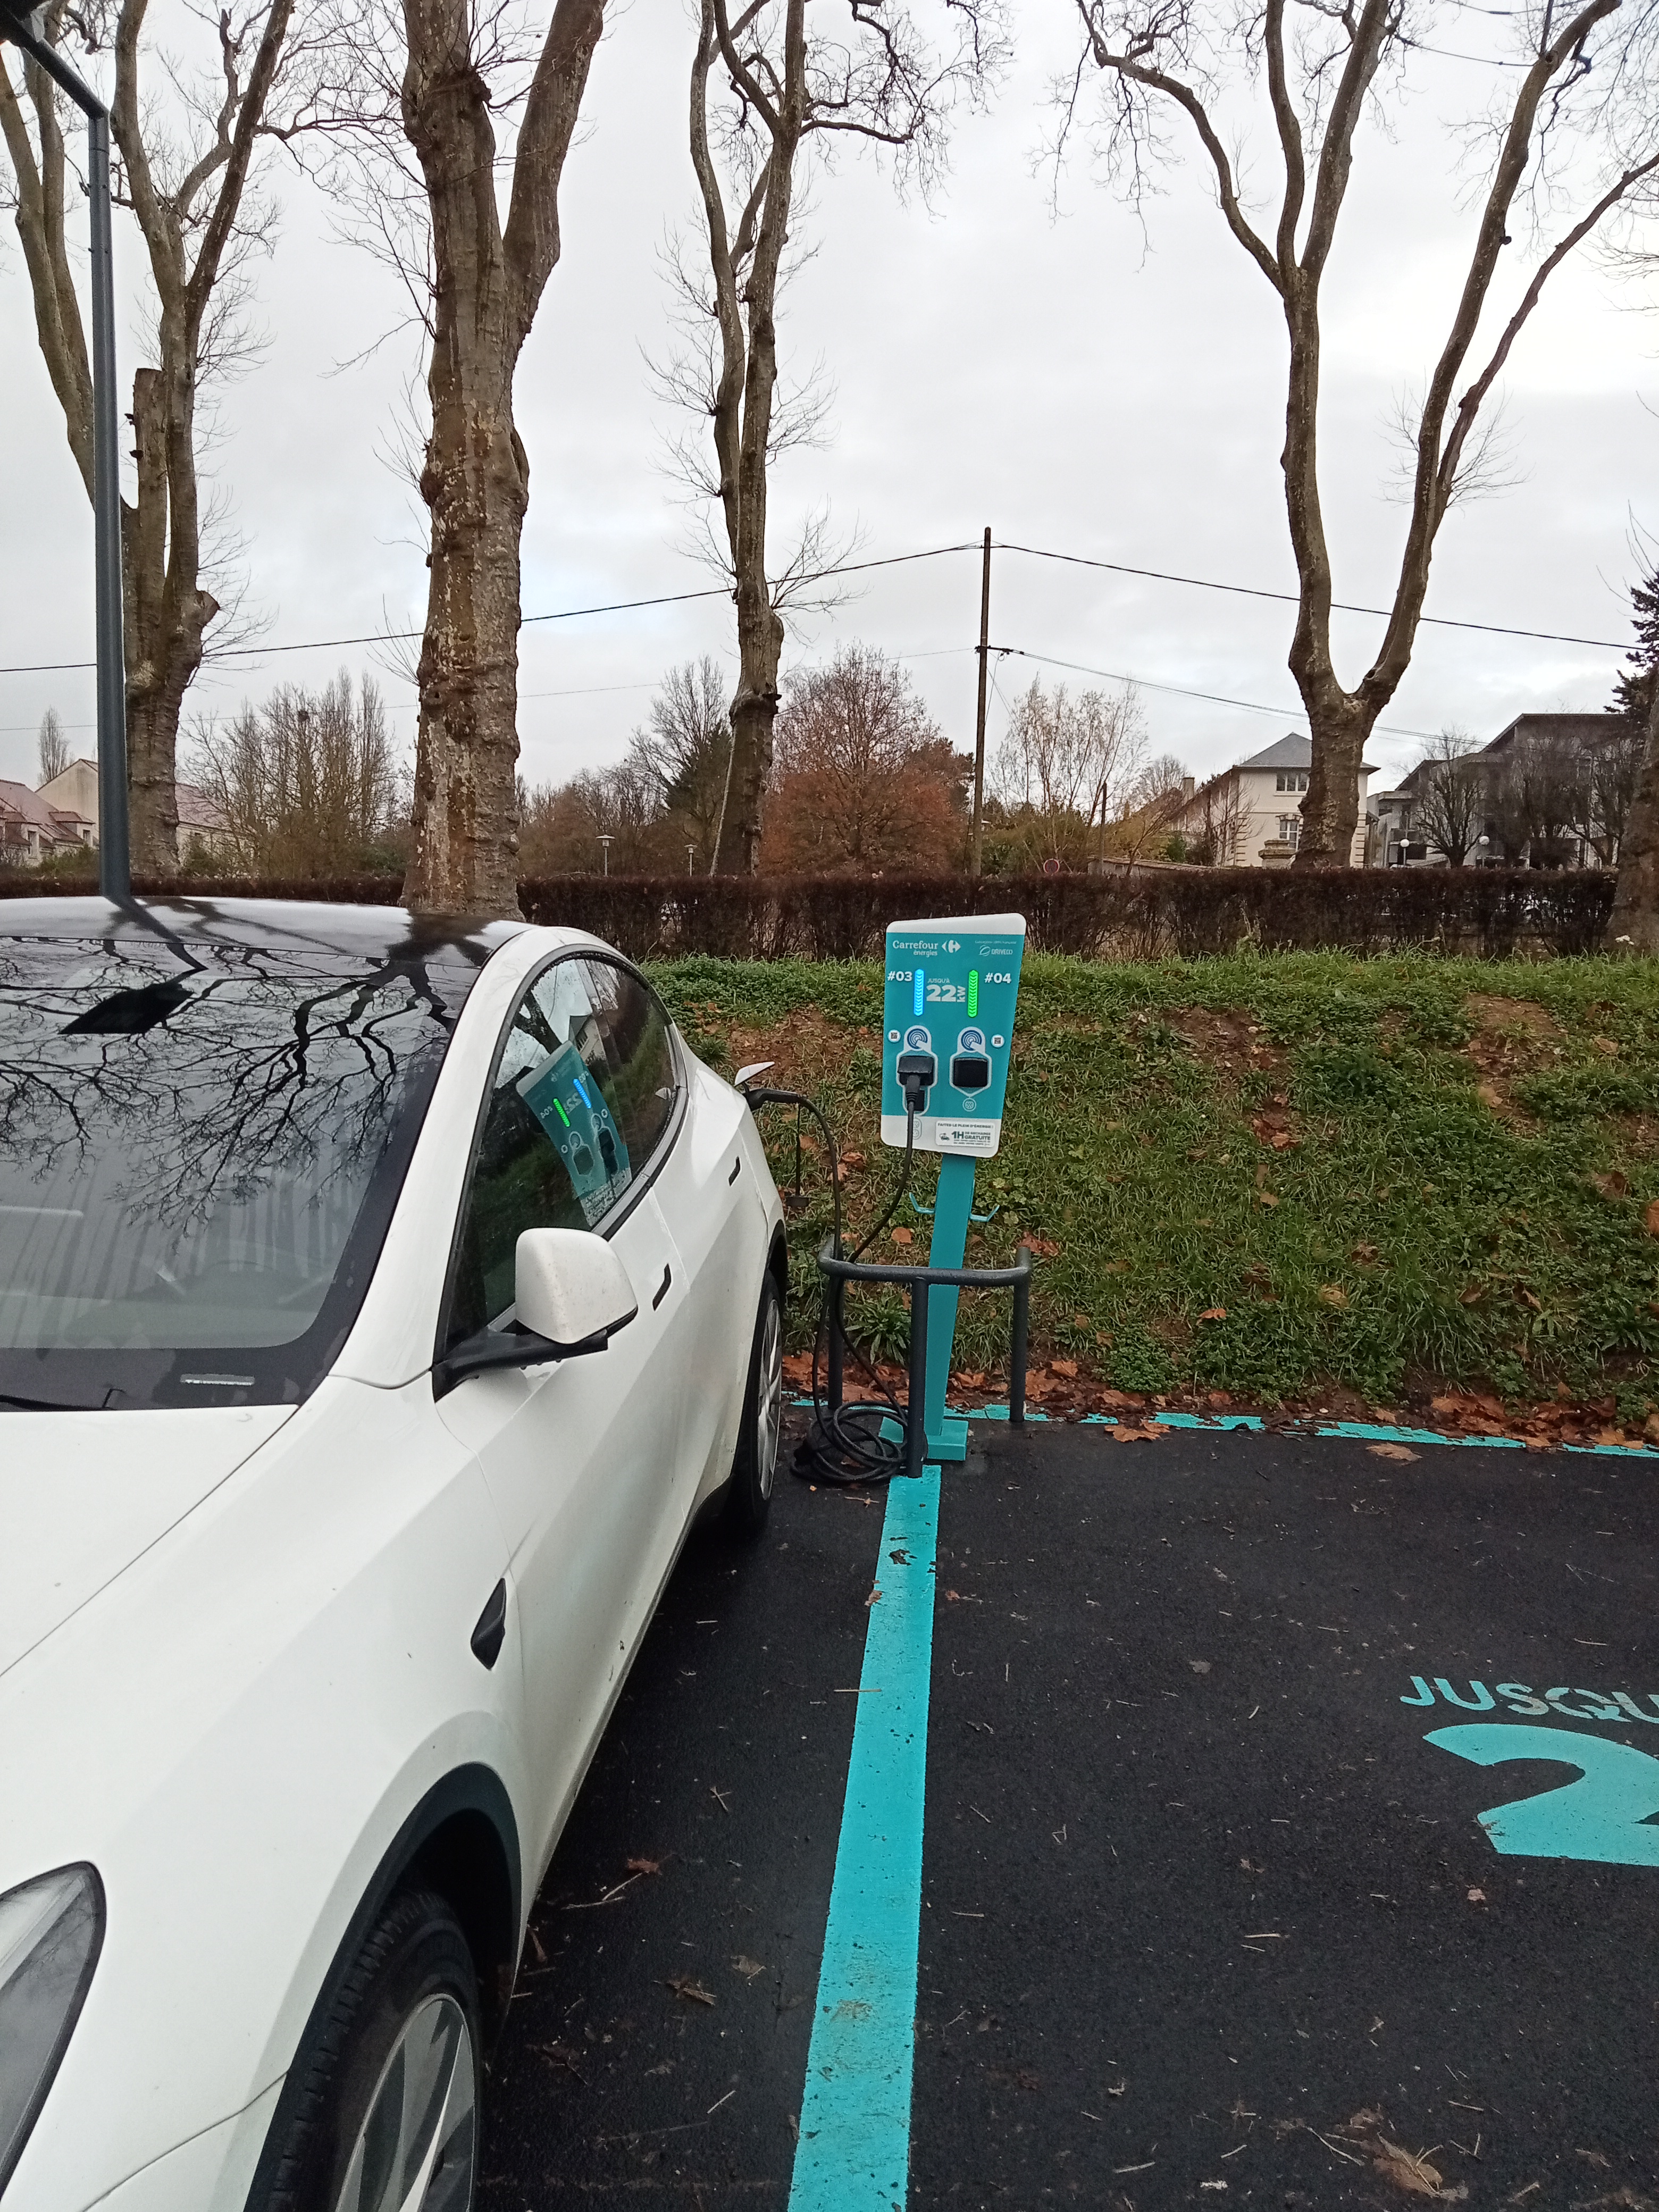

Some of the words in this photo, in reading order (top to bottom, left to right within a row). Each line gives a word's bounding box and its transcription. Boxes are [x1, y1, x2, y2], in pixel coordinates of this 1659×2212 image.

[893, 940, 939, 949] Carrefour
[887, 971, 912, 982] #03
[985, 973, 1011, 984] #04
[926, 984, 956, 1002] 22
[957, 985, 966, 1002] kW
